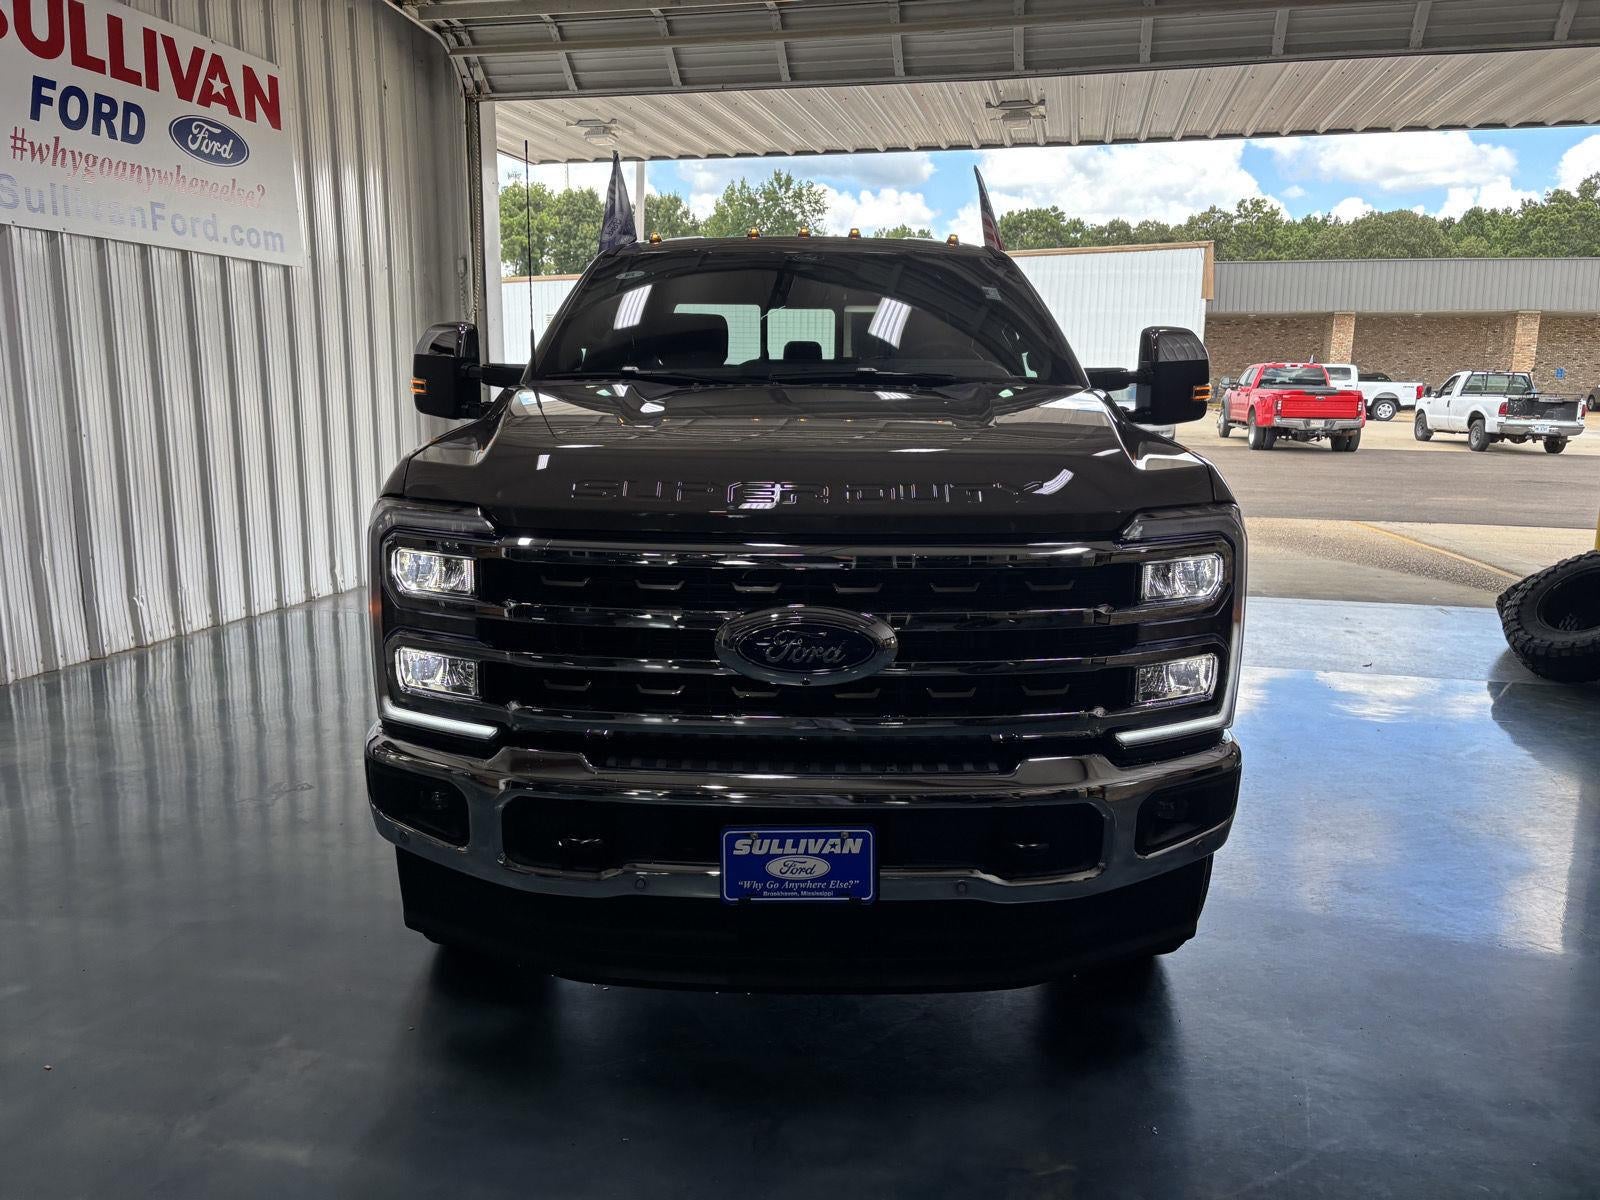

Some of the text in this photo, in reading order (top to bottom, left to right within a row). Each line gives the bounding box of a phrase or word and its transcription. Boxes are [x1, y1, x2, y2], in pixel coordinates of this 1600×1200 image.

[0, 0, 282, 131] ULLIVAN
[29, 74, 146, 145] FORD
[187, 120, 234, 160] Ford
[10, 125, 266, 208] #whygoanywhereelse?
[764, 630, 849, 664] Ford
[733, 838, 863, 856] SULLIVAN
[766, 880, 779, 889] Go
[781, 880, 827, 891] Anywhere
[779, 859, 816, 876] Ford
